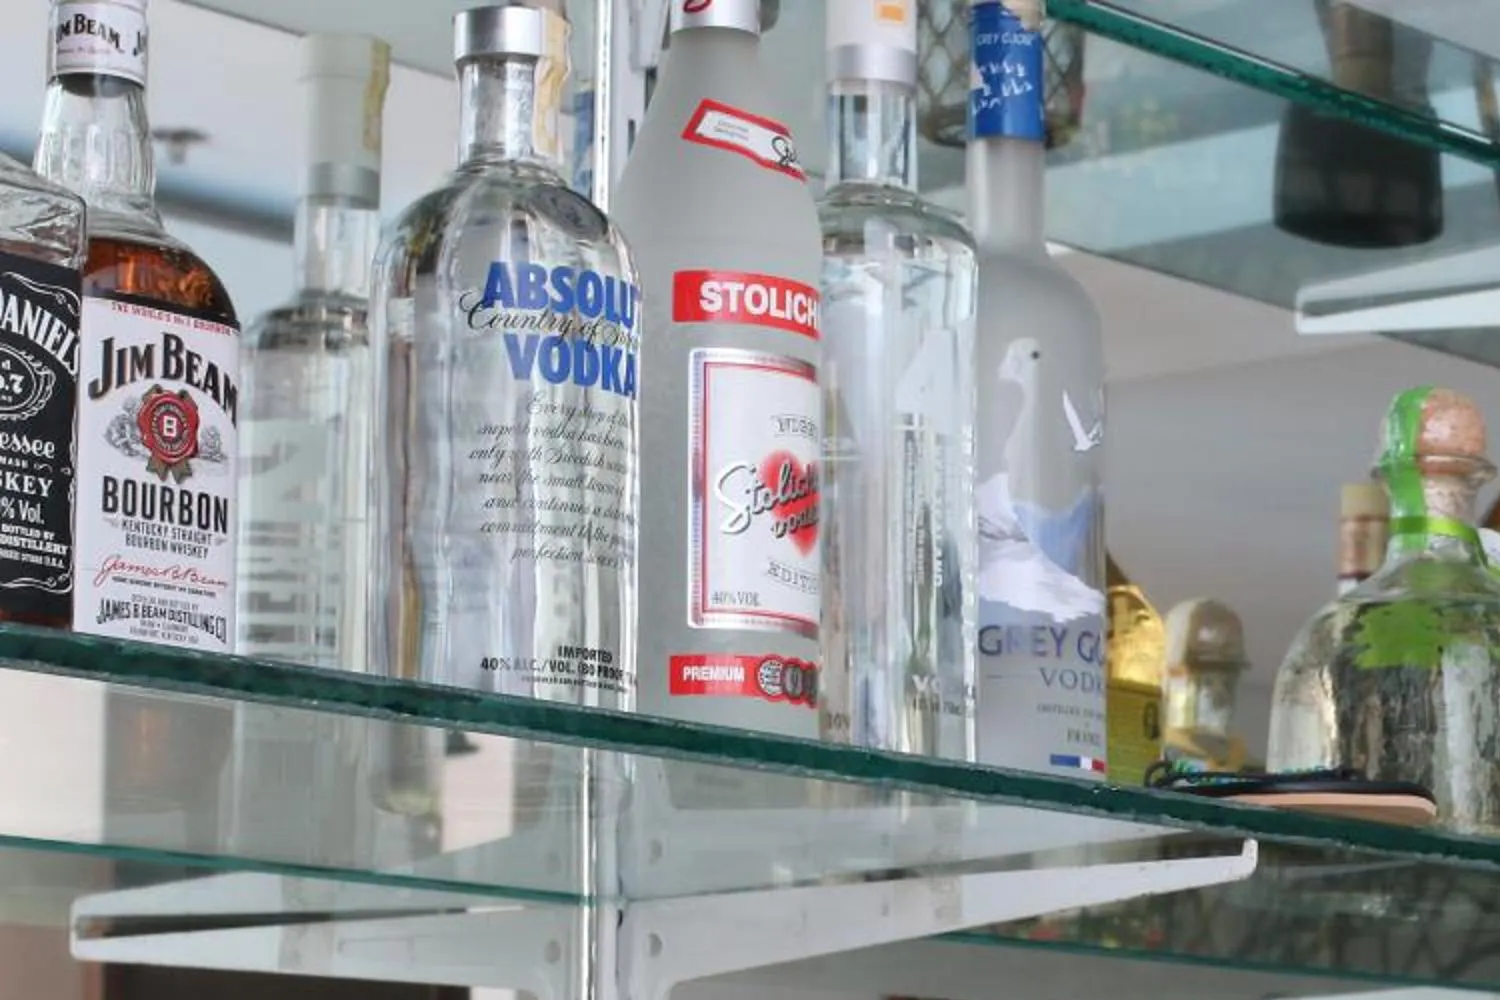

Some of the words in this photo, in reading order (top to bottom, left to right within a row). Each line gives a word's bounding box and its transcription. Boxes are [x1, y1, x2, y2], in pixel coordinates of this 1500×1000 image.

[73, 13, 120, 48] BEAM
[88, 336, 155, 400] JIM
[162, 332, 239, 428] BEAM
[503, 333, 637, 400] VODKA
[163, 415, 177, 437] B
[0, 469, 52, 497] KEY
[18, 499, 44, 525] Vol.
[102, 475, 228, 534] BOURBON
[558, 645, 613, 664] IMPORTED
[682, 664, 745, 683] PREMIUM
